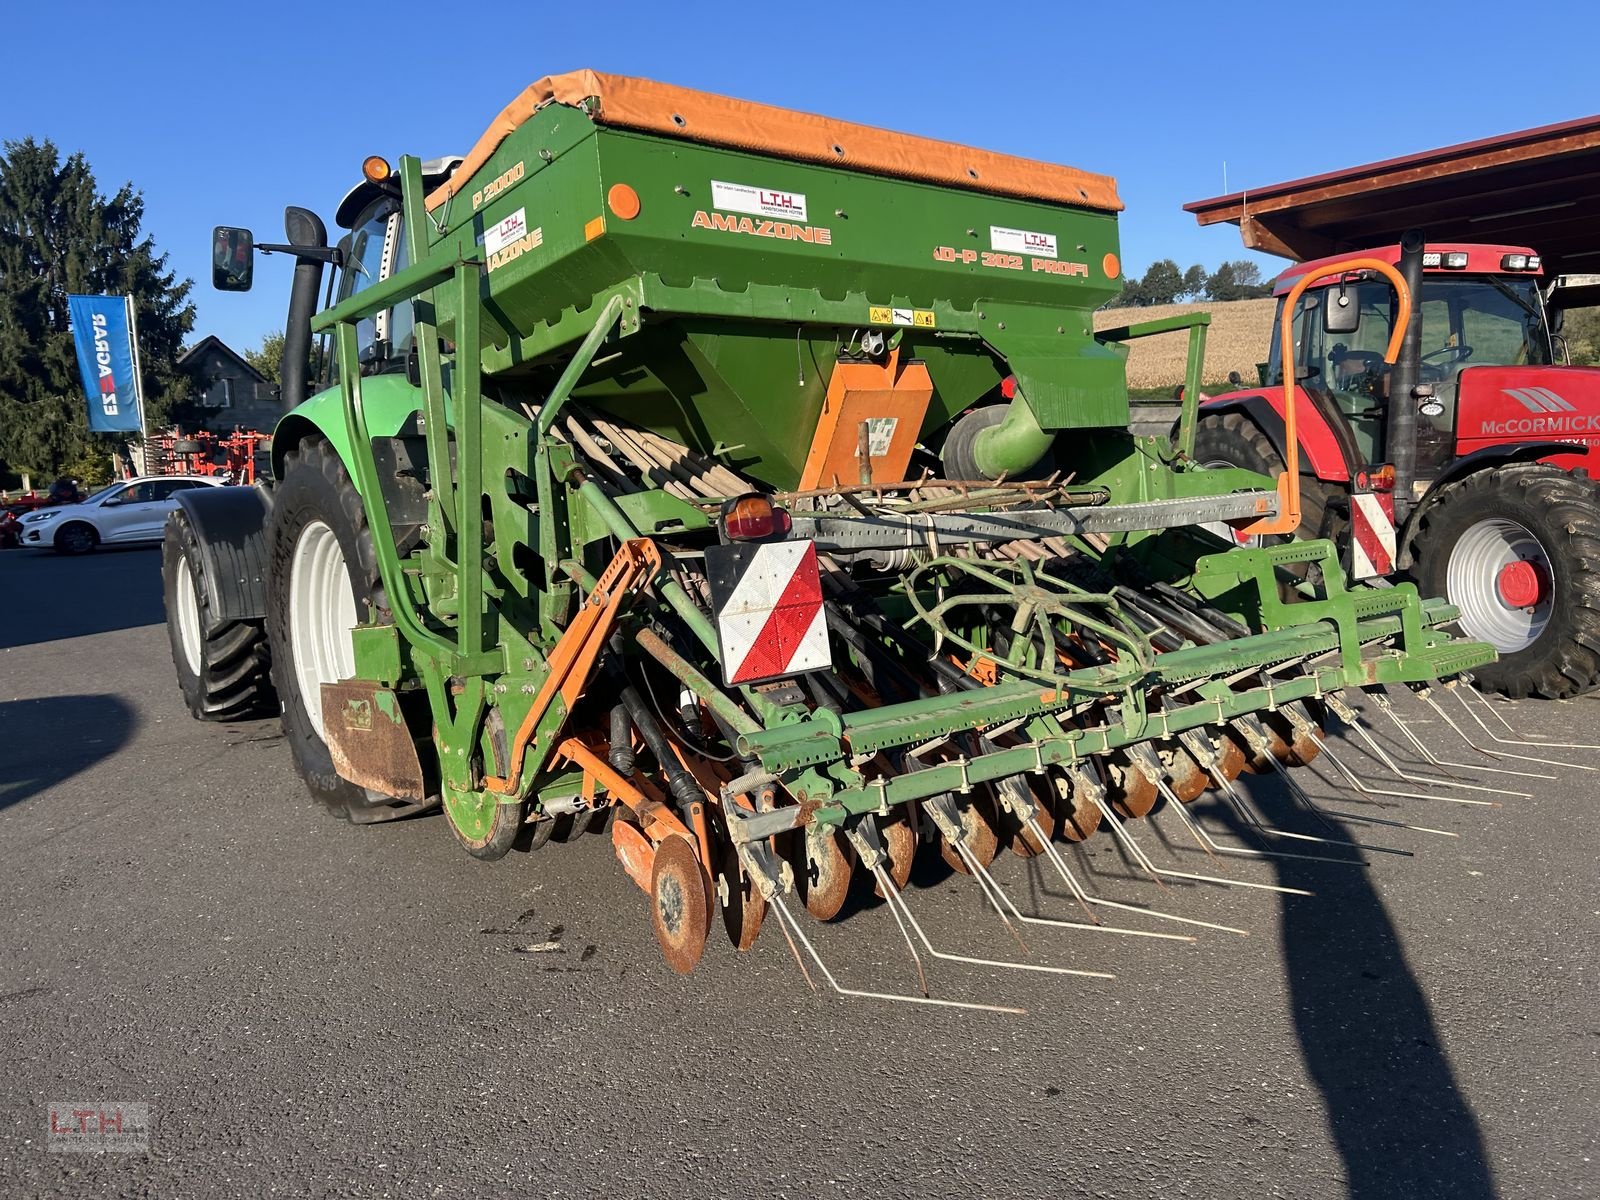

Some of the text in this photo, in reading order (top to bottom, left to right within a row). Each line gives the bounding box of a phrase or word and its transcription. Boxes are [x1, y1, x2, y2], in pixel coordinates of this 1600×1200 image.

[472, 160, 525, 211] P 2000
[691, 210, 832, 246] AMAZONE
[981, 251, 1024, 270] 302
[1031, 258, 1089, 278] PROFI
[1481, 415, 1600, 434] McCORMICK
